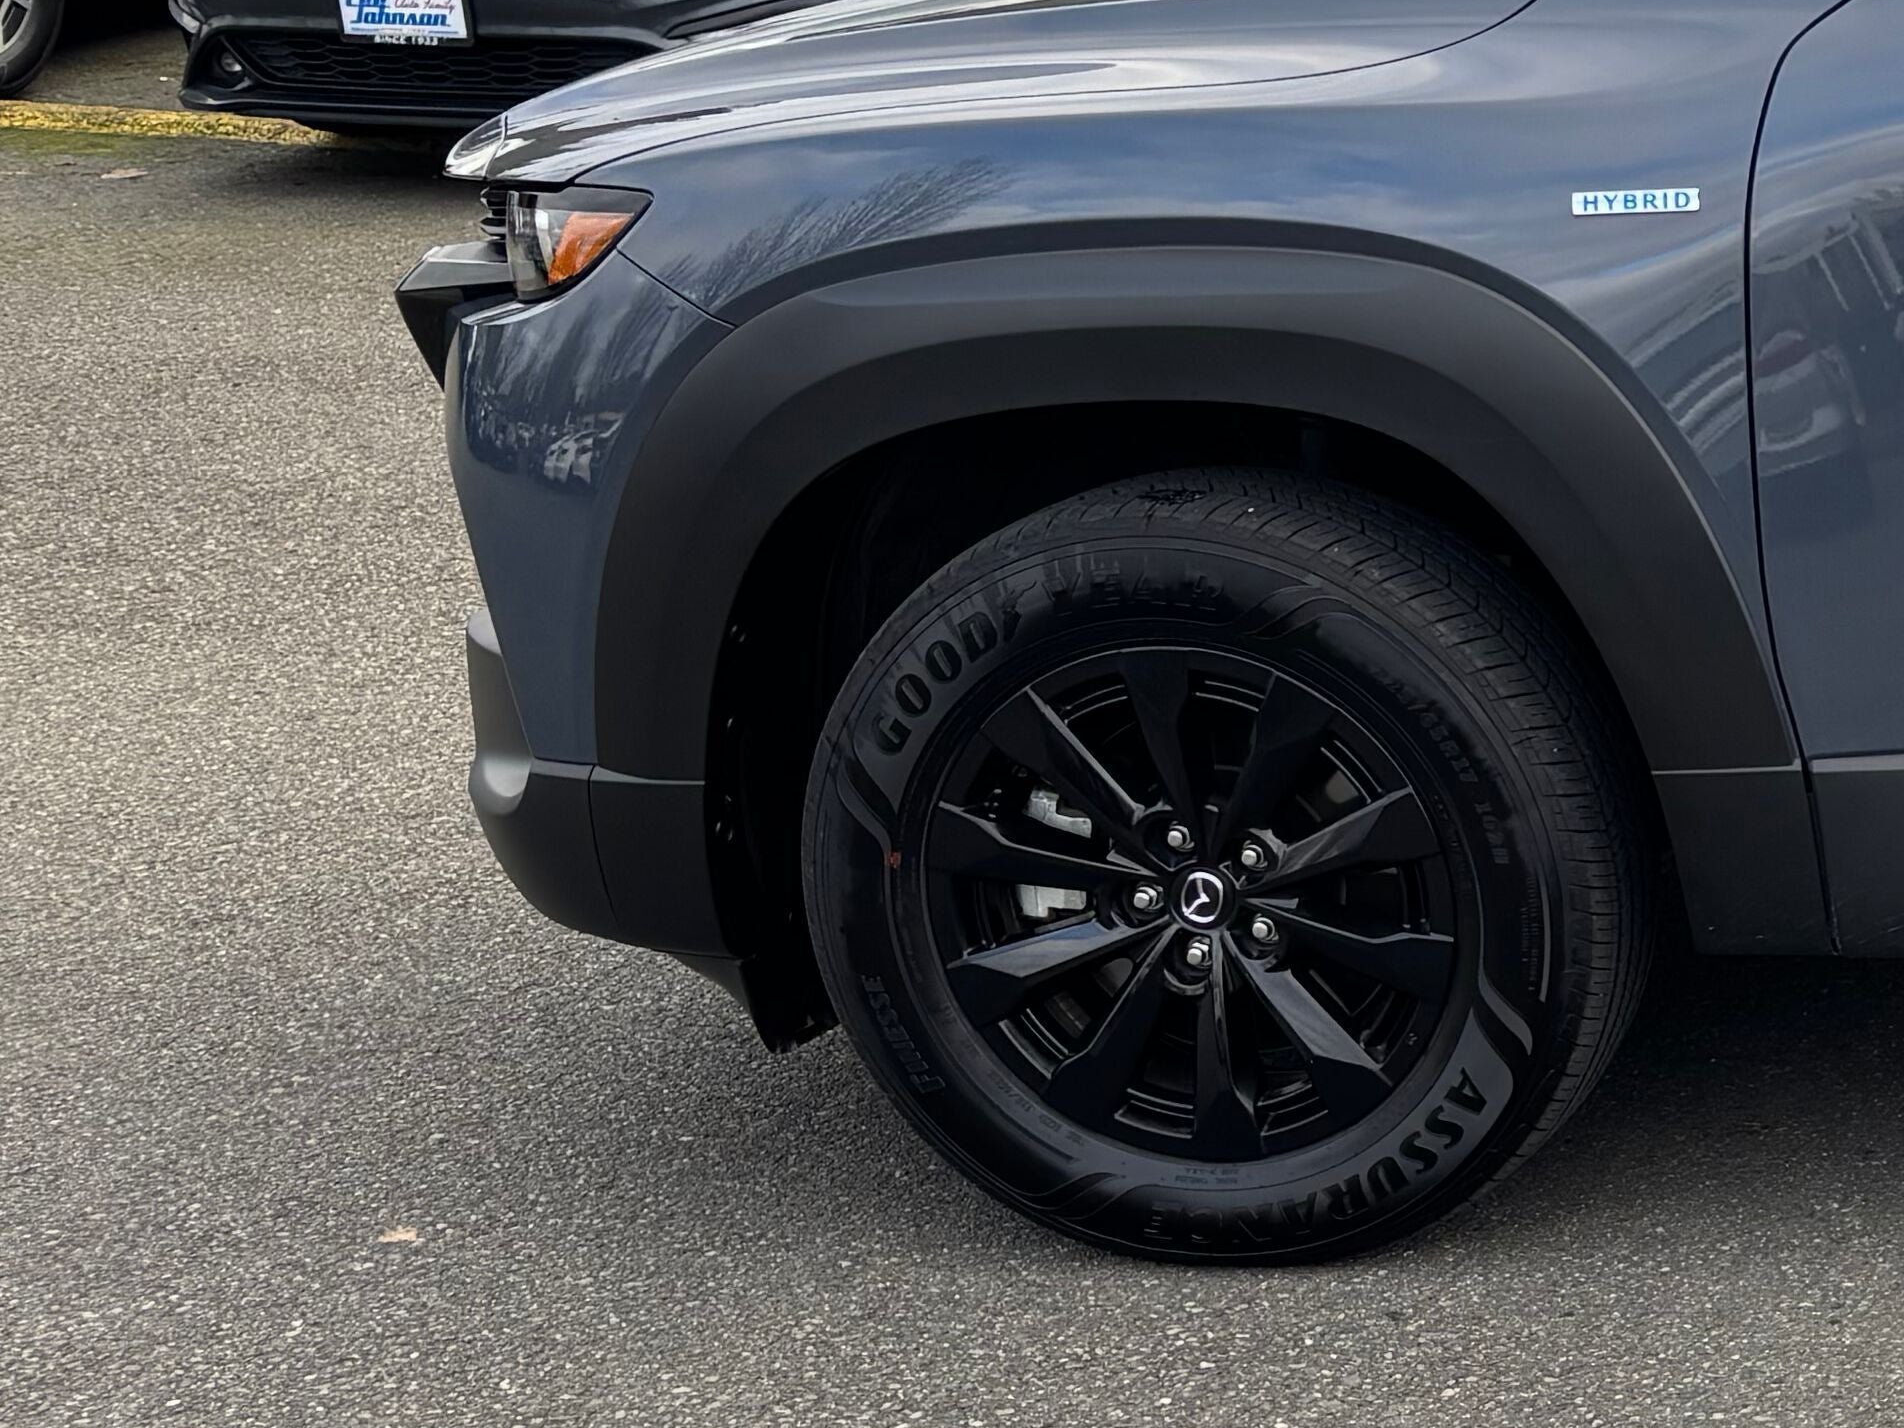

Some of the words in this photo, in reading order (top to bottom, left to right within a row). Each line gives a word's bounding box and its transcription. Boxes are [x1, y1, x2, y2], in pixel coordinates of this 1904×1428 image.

[350, 5, 452, 27] Johnson
[1583, 192, 1691, 212] HYBRID
[1142, 1066, 1489, 1243] ASSURANCE
